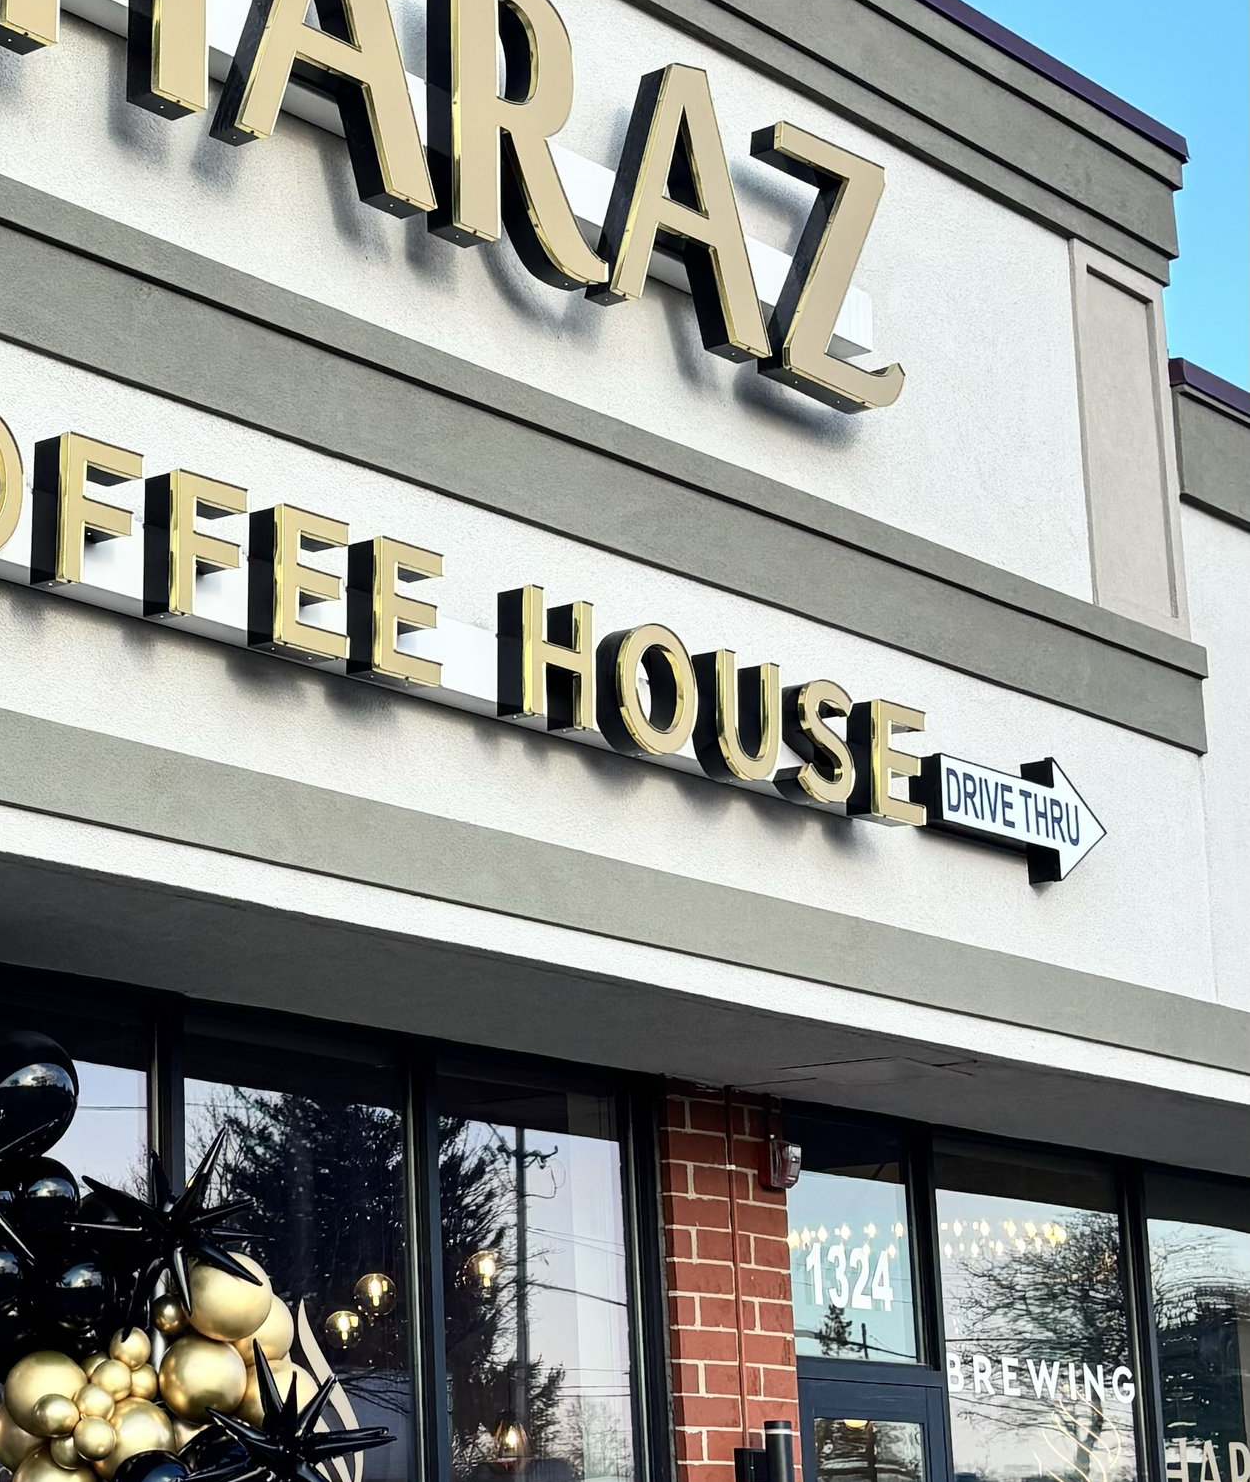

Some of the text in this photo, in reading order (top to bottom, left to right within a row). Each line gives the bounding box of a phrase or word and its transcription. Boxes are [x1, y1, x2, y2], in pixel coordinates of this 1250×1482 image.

[499, 583, 928, 826] HOUSE
[946, 767, 1080, 846] DRIVE THRU
[806, 1242, 894, 1312] 1324
[946, 1352, 1136, 1404] BREWING
